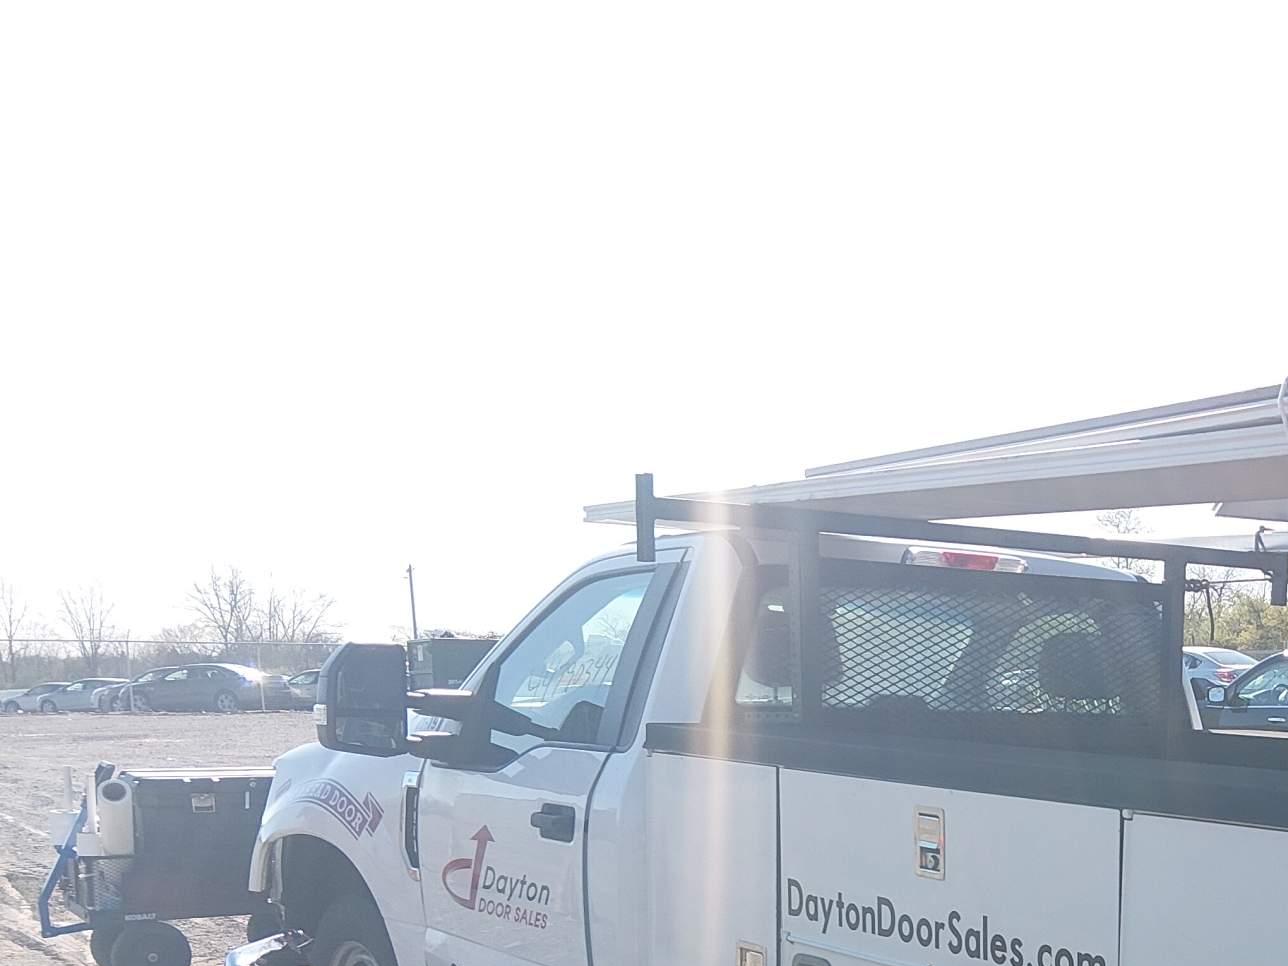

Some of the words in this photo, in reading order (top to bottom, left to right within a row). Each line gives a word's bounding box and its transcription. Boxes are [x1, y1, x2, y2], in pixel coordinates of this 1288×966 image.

[328, 787, 364, 832] DOOR
[482, 865, 550, 905] Dayton
[478, 898, 512, 920] DOOR
[513, 907, 549, 929] SALES
